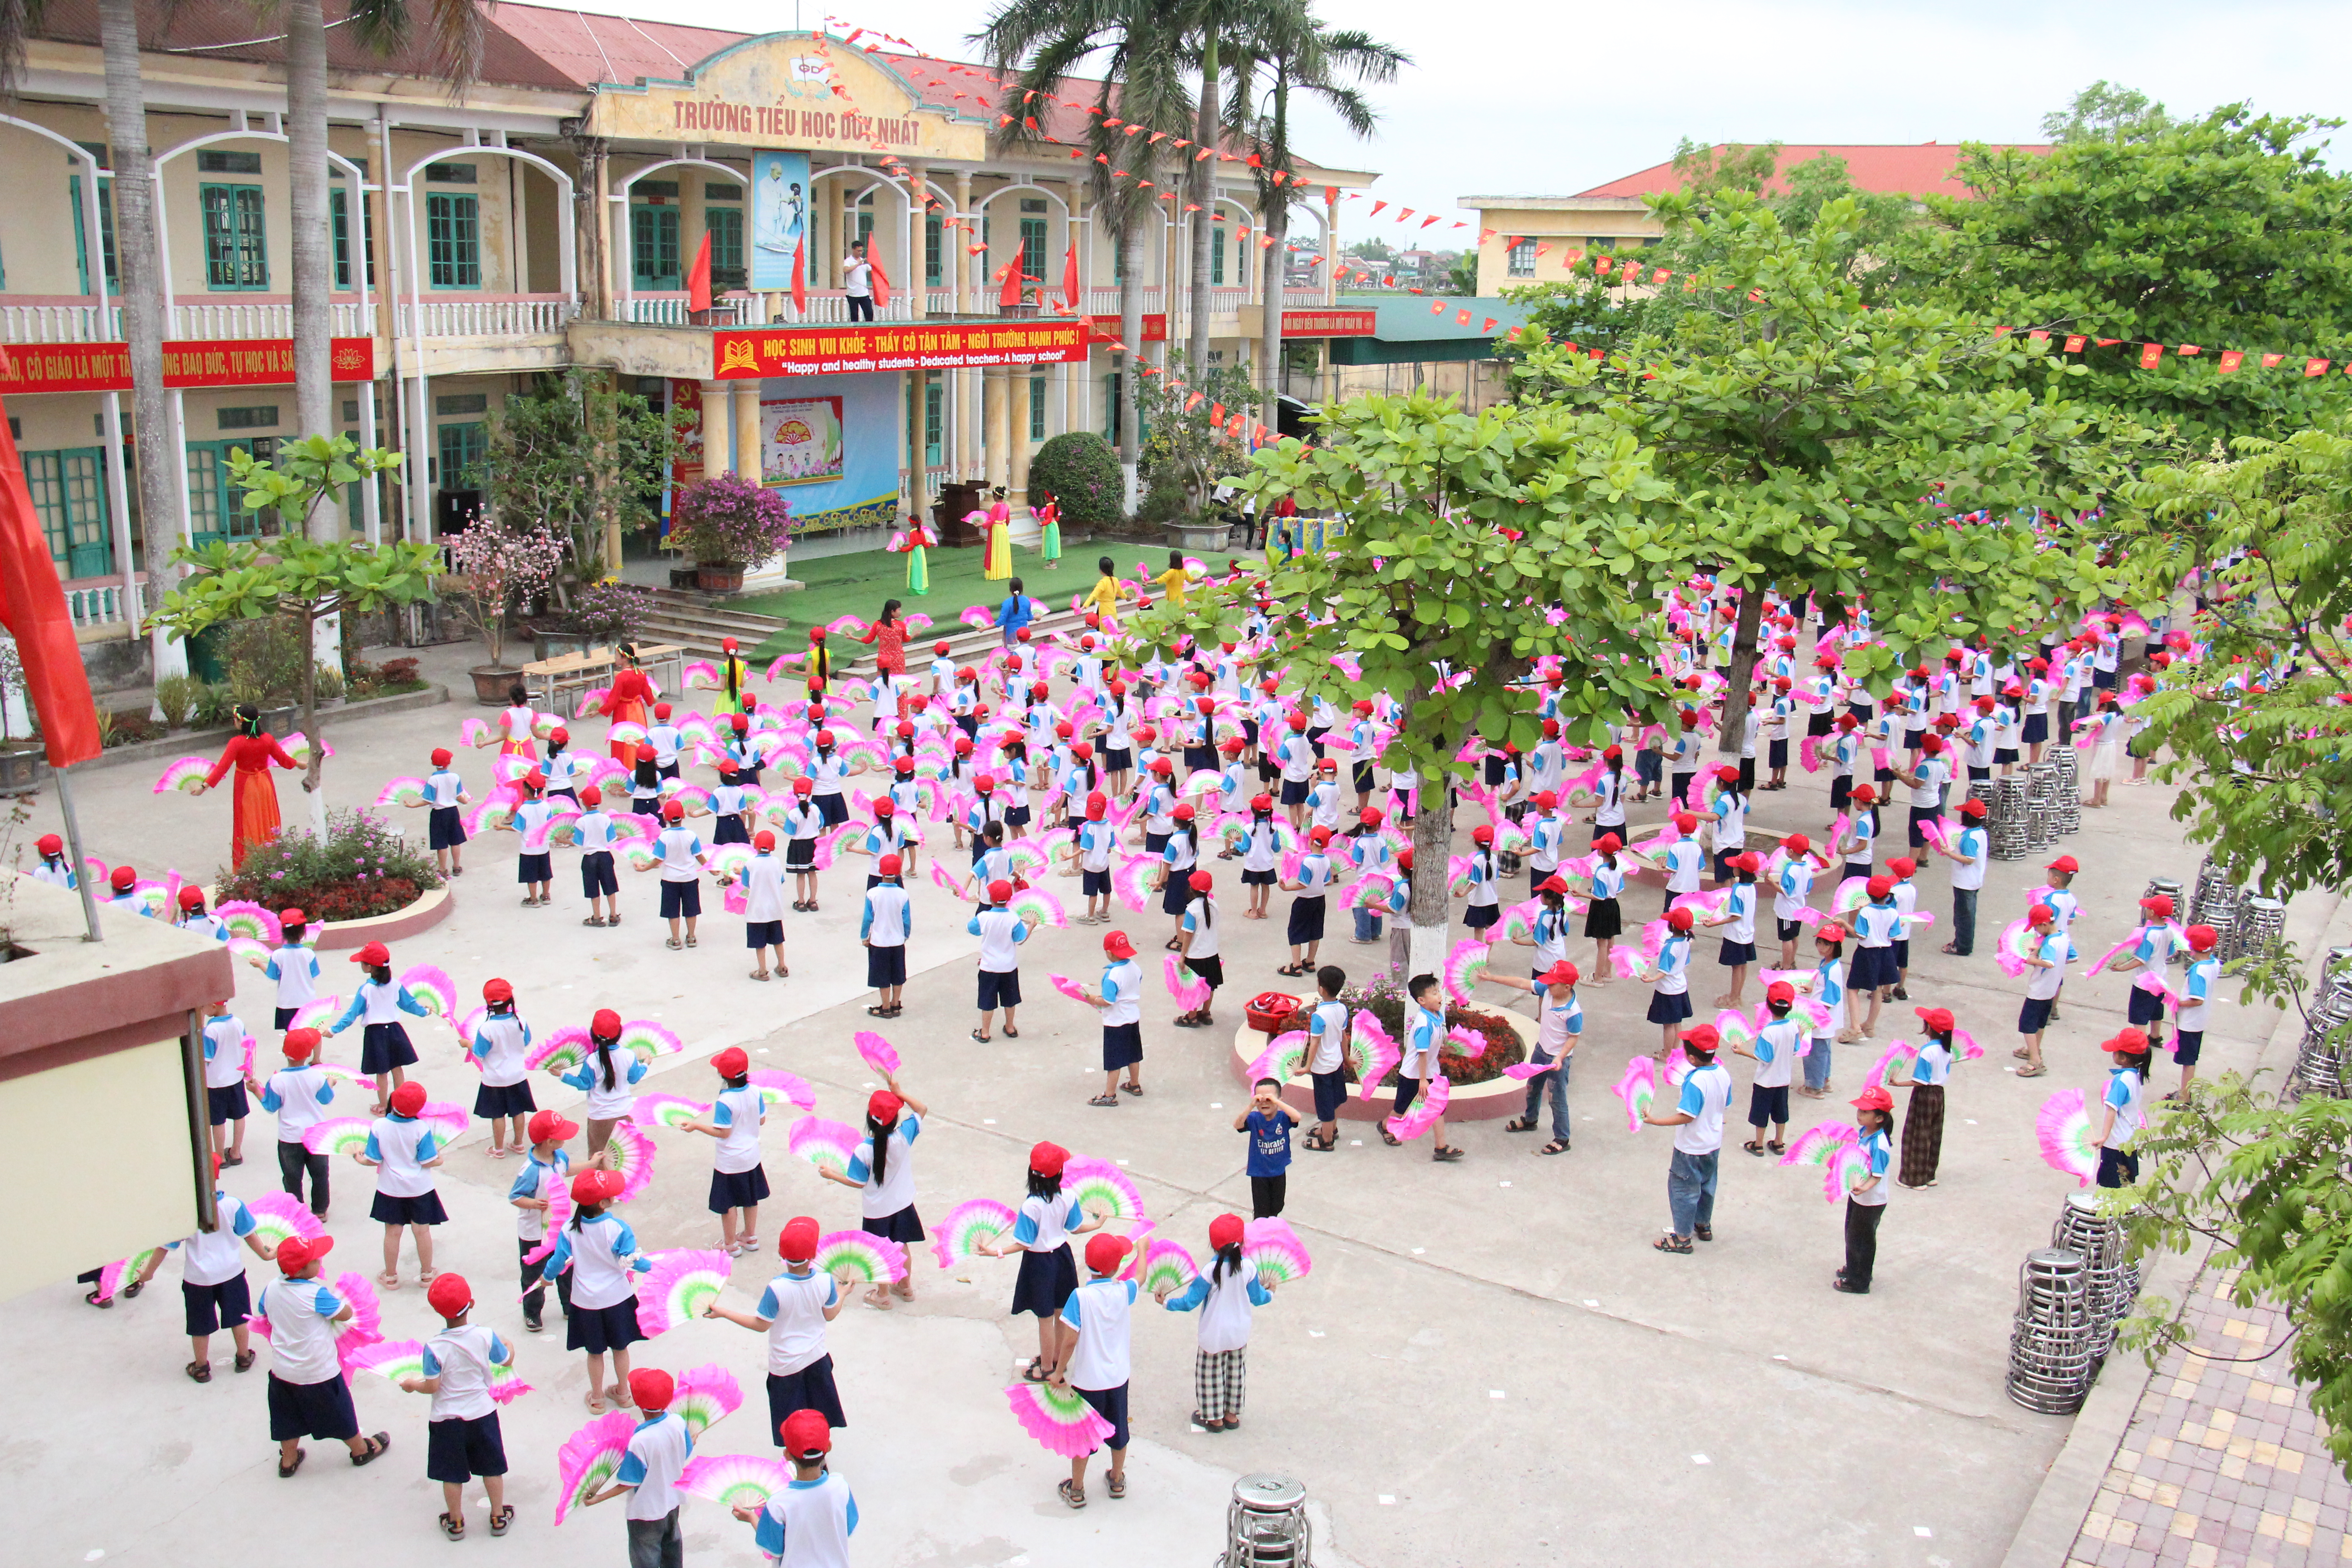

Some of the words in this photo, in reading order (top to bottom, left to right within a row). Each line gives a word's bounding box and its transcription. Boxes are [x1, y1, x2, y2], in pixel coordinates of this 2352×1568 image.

[673, 94, 751, 133] TRƯỜNG
[756, 94, 796, 136] TIỂU
[802, 111, 835, 144] HỌC
[841, 114, 872, 142] DUY
[764, 339, 786, 360] HỌC
[789, 338, 816, 356] SINH
[819, 338, 836, 355] VUI
[839, 331, 866, 354] KHỎE
[874, 330, 899, 353] THẦY
[903, 331, 916, 352] CÔ
[918, 331, 937, 354] TẬN
[940, 331, 960, 350] TÂM
[968, 329, 990, 349] NGÔI
[992, 329, 1026, 348] TRƯỜNG
[1029, 331, 1051, 349] HẠNH
[26, 351, 43, 381] CÔ
[45, 350, 73, 380] GIÁO
[74, 349, 89, 378] LÀ
[91, 350, 114, 383] MỘT
[230, 351, 243, 378] TỰ
[244, 351, 264, 377] HỌC
[266, 346, 279, 372] VÀ
[822, 359, 840, 372] and
[843, 358, 876, 372] healthy
[1012, 352, 1036, 364] happy
[1257, 1137, 1285, 1148] Emirates
[1269, 1145, 1284, 1155] BETTER
